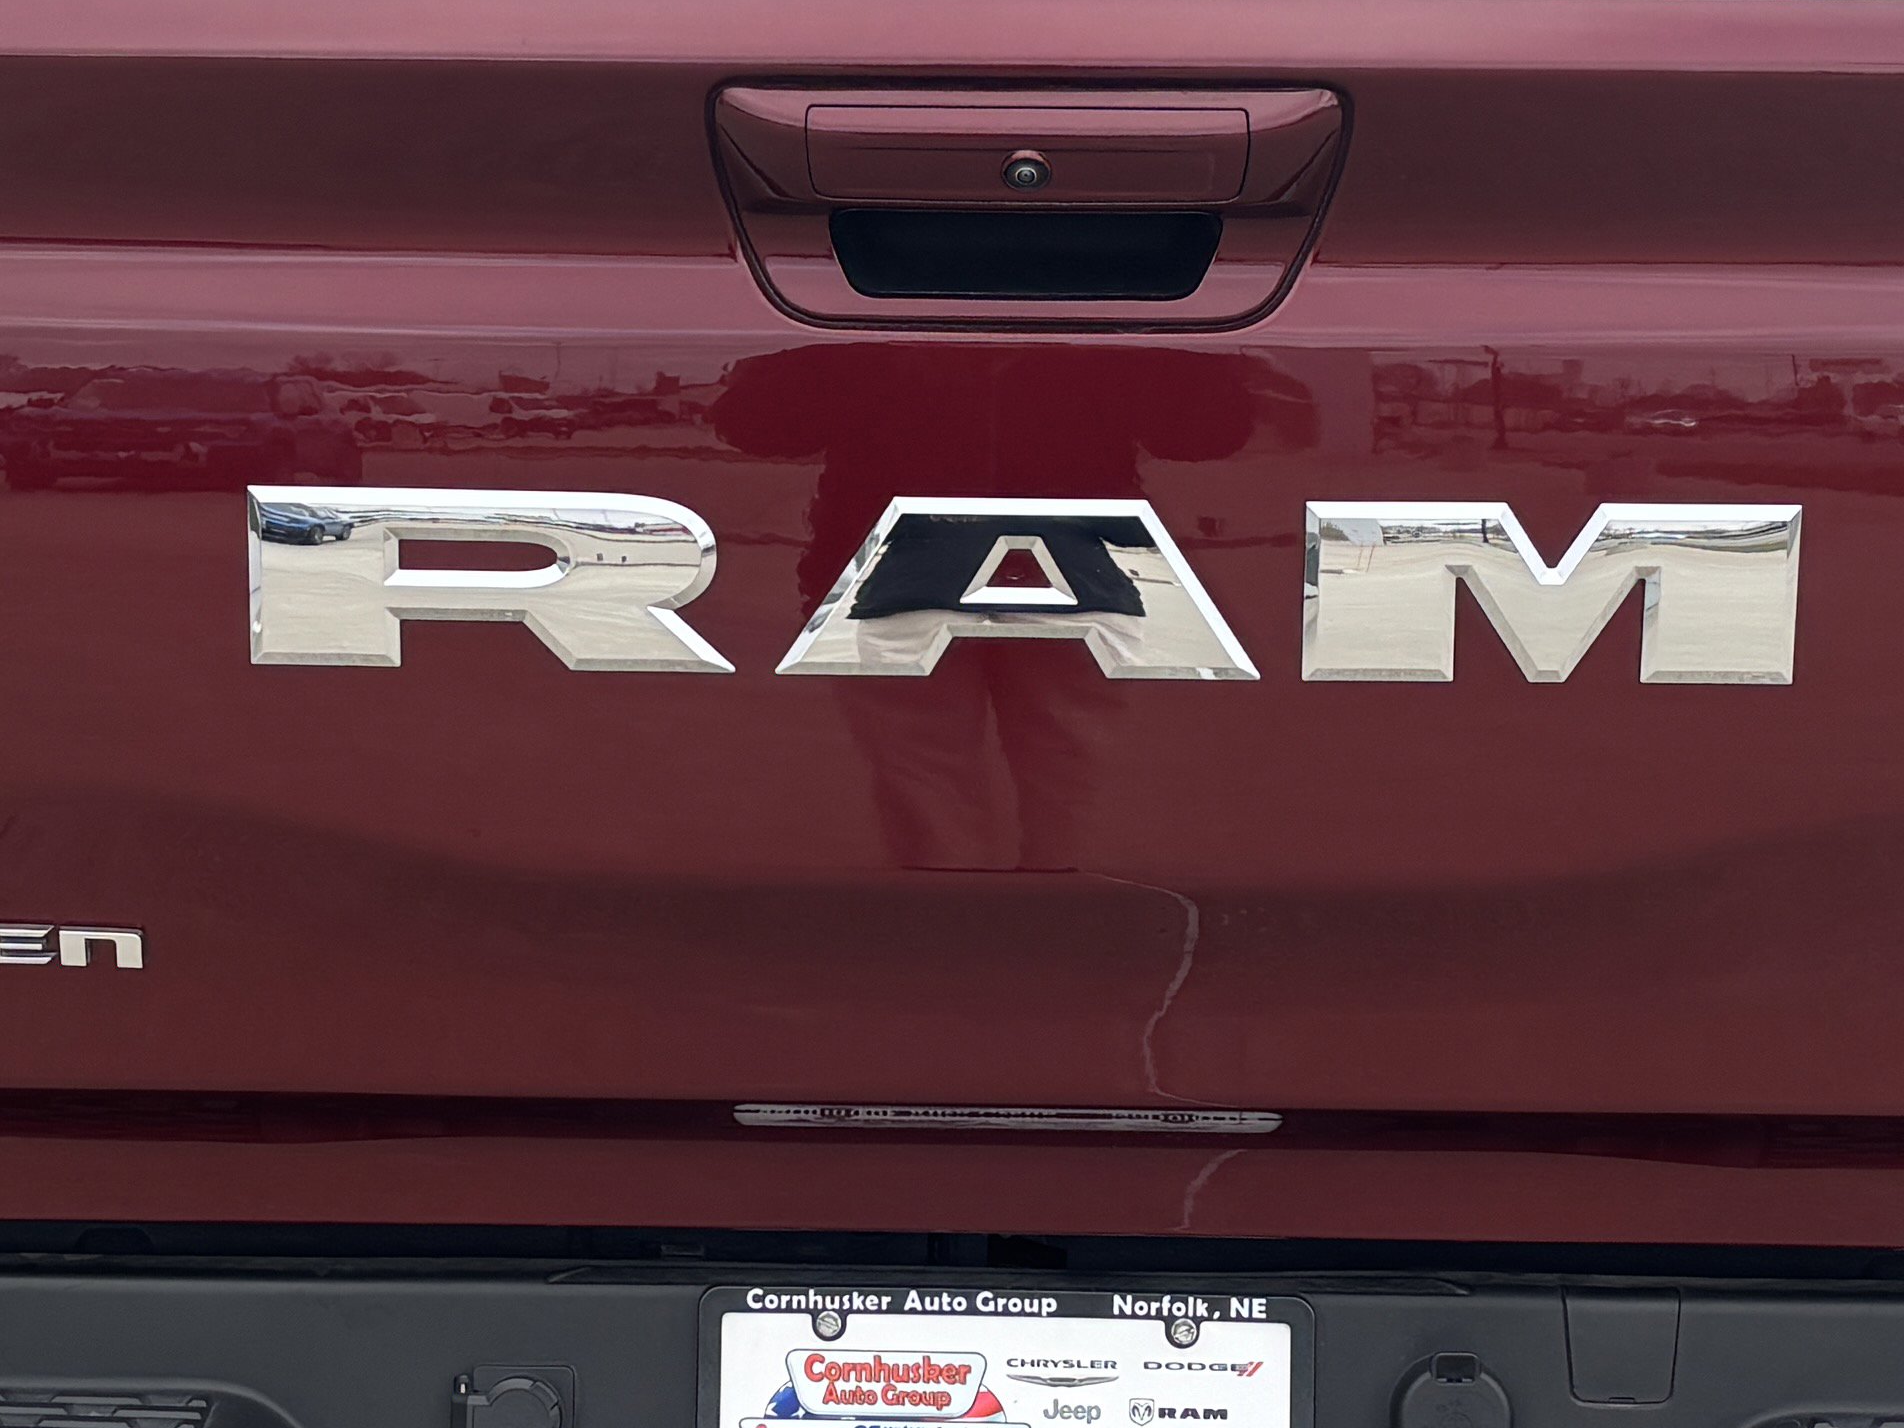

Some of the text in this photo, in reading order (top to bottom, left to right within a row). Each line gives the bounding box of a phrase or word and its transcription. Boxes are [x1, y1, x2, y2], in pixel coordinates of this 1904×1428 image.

[246, 483, 1804, 685] RAM
[746, 1287, 1058, 1316] Cornhusker Auto Group
[1112, 1293, 1267, 1319] Norfolk, NE
[804, 1353, 972, 1385] Cornhusker
[1006, 1358, 1118, 1370] CHRYSLER
[1143, 1360, 1249, 1373] DODGE
[822, 1381, 952, 1411] Auto Group
[1043, 1398, 1102, 1423] Jeep
[1158, 1406, 1228, 1420] RAM
